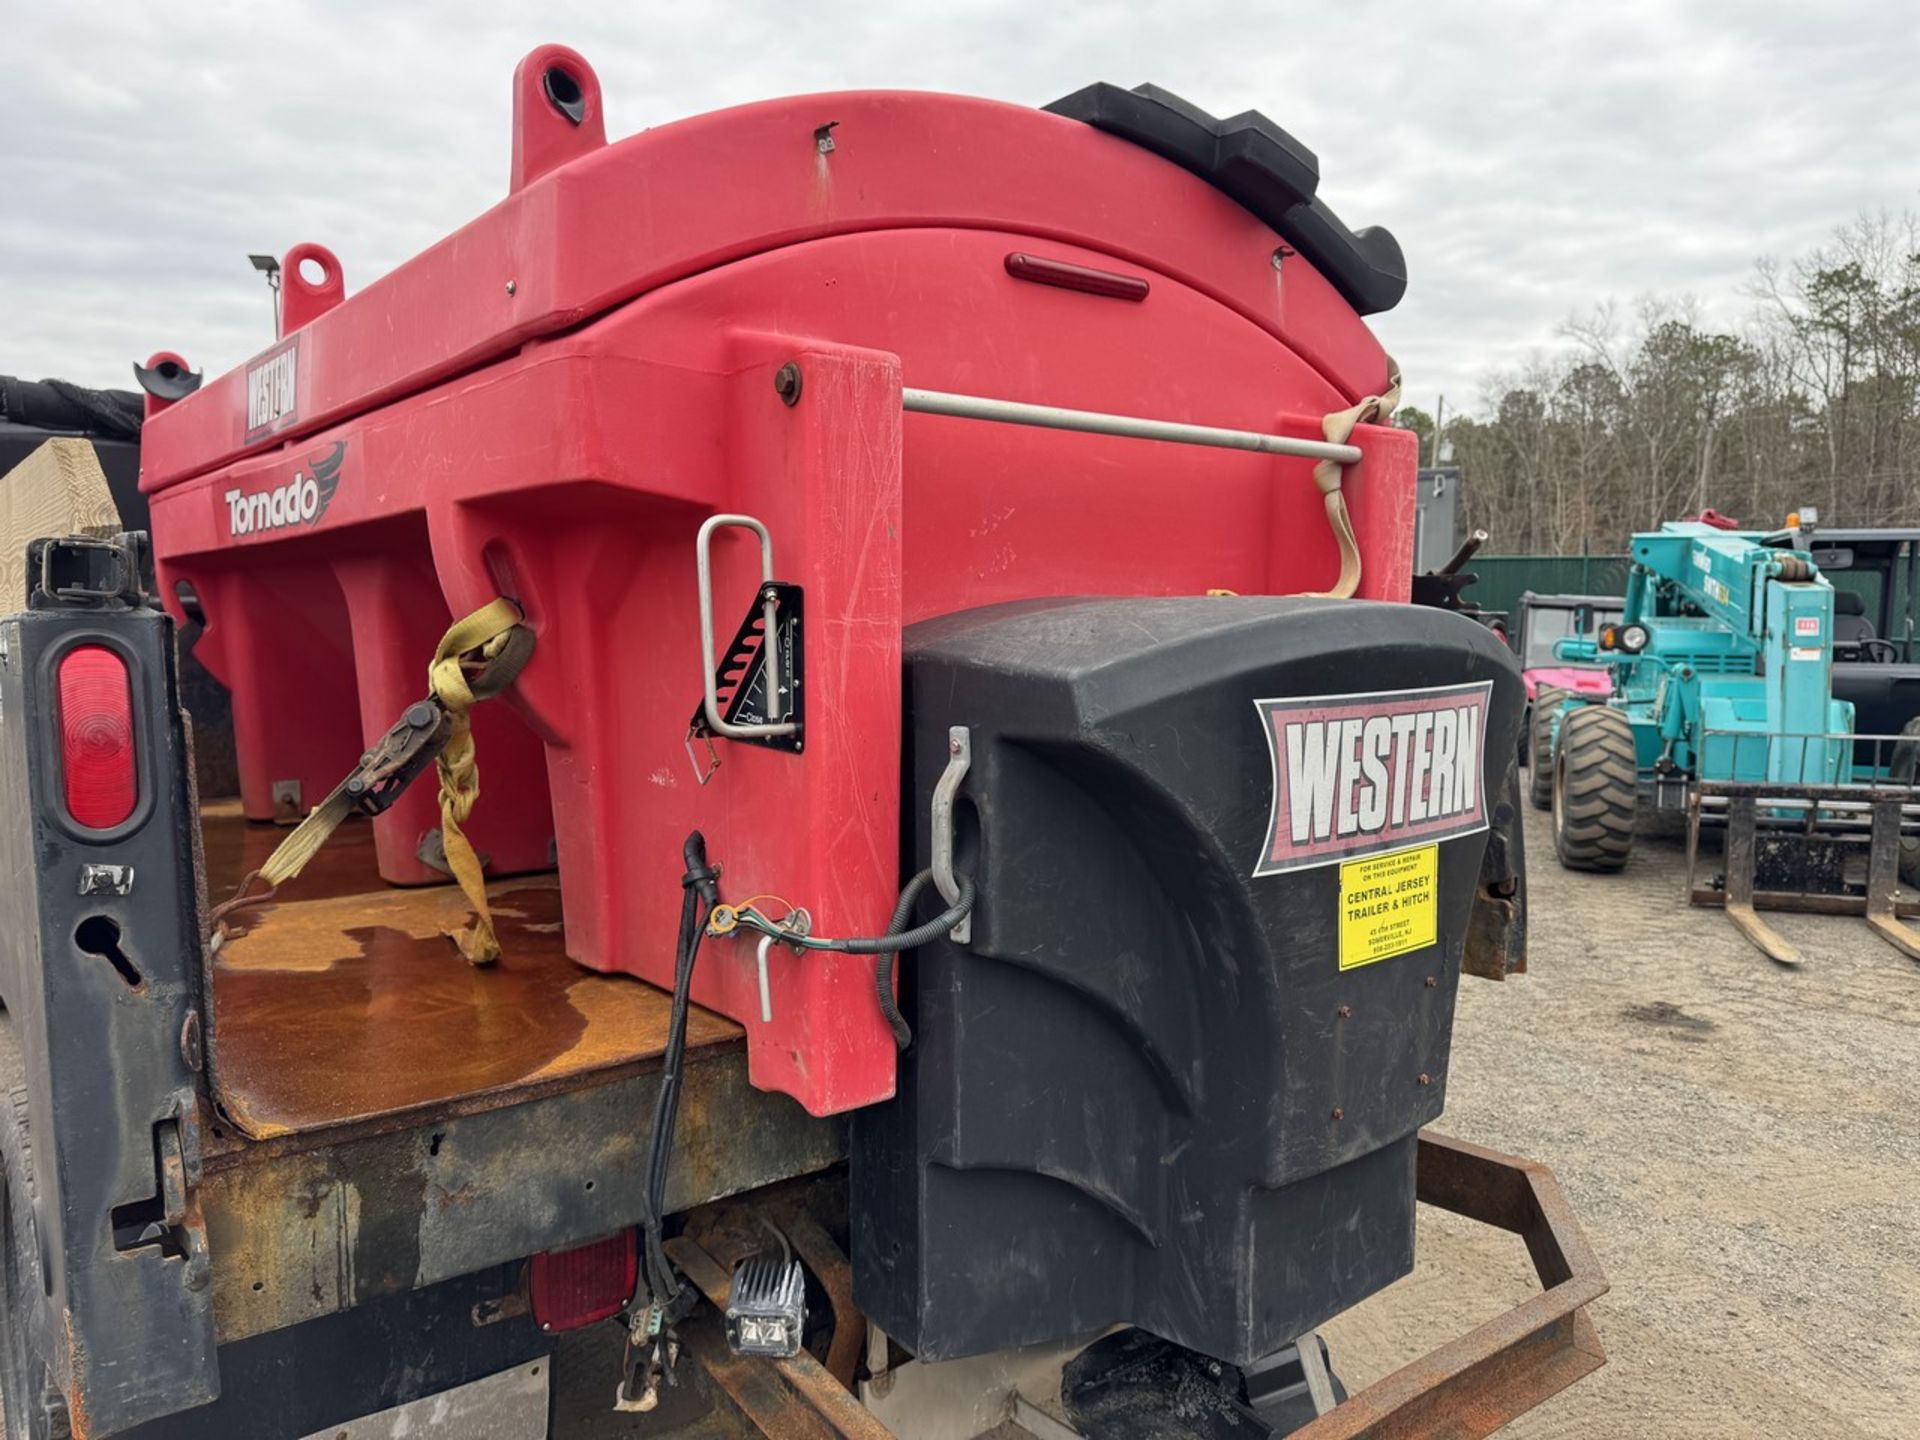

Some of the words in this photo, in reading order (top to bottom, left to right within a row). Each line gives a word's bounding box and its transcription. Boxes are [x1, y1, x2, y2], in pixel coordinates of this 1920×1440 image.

[248, 347, 296, 431] WESTERN
[225, 473, 319, 535] Tornado
[1286, 704, 1478, 844] WESTERN
[1360, 865, 1371, 873] FOR
[1373, 859, 1396, 870] SERVICE
[1373, 870, 1385, 879] THIS
[1387, 863, 1418, 876] EQUIPMENT
[1347, 886, 1392, 905] CENTRAL
[1396, 875, 1430, 894] JERSEY
[1348, 902, 1389, 922] TRAILER
[1392, 899, 1399, 911] &
[1402, 891, 1430, 908] HITCH
[1390, 919, 1410, 930] STREET
